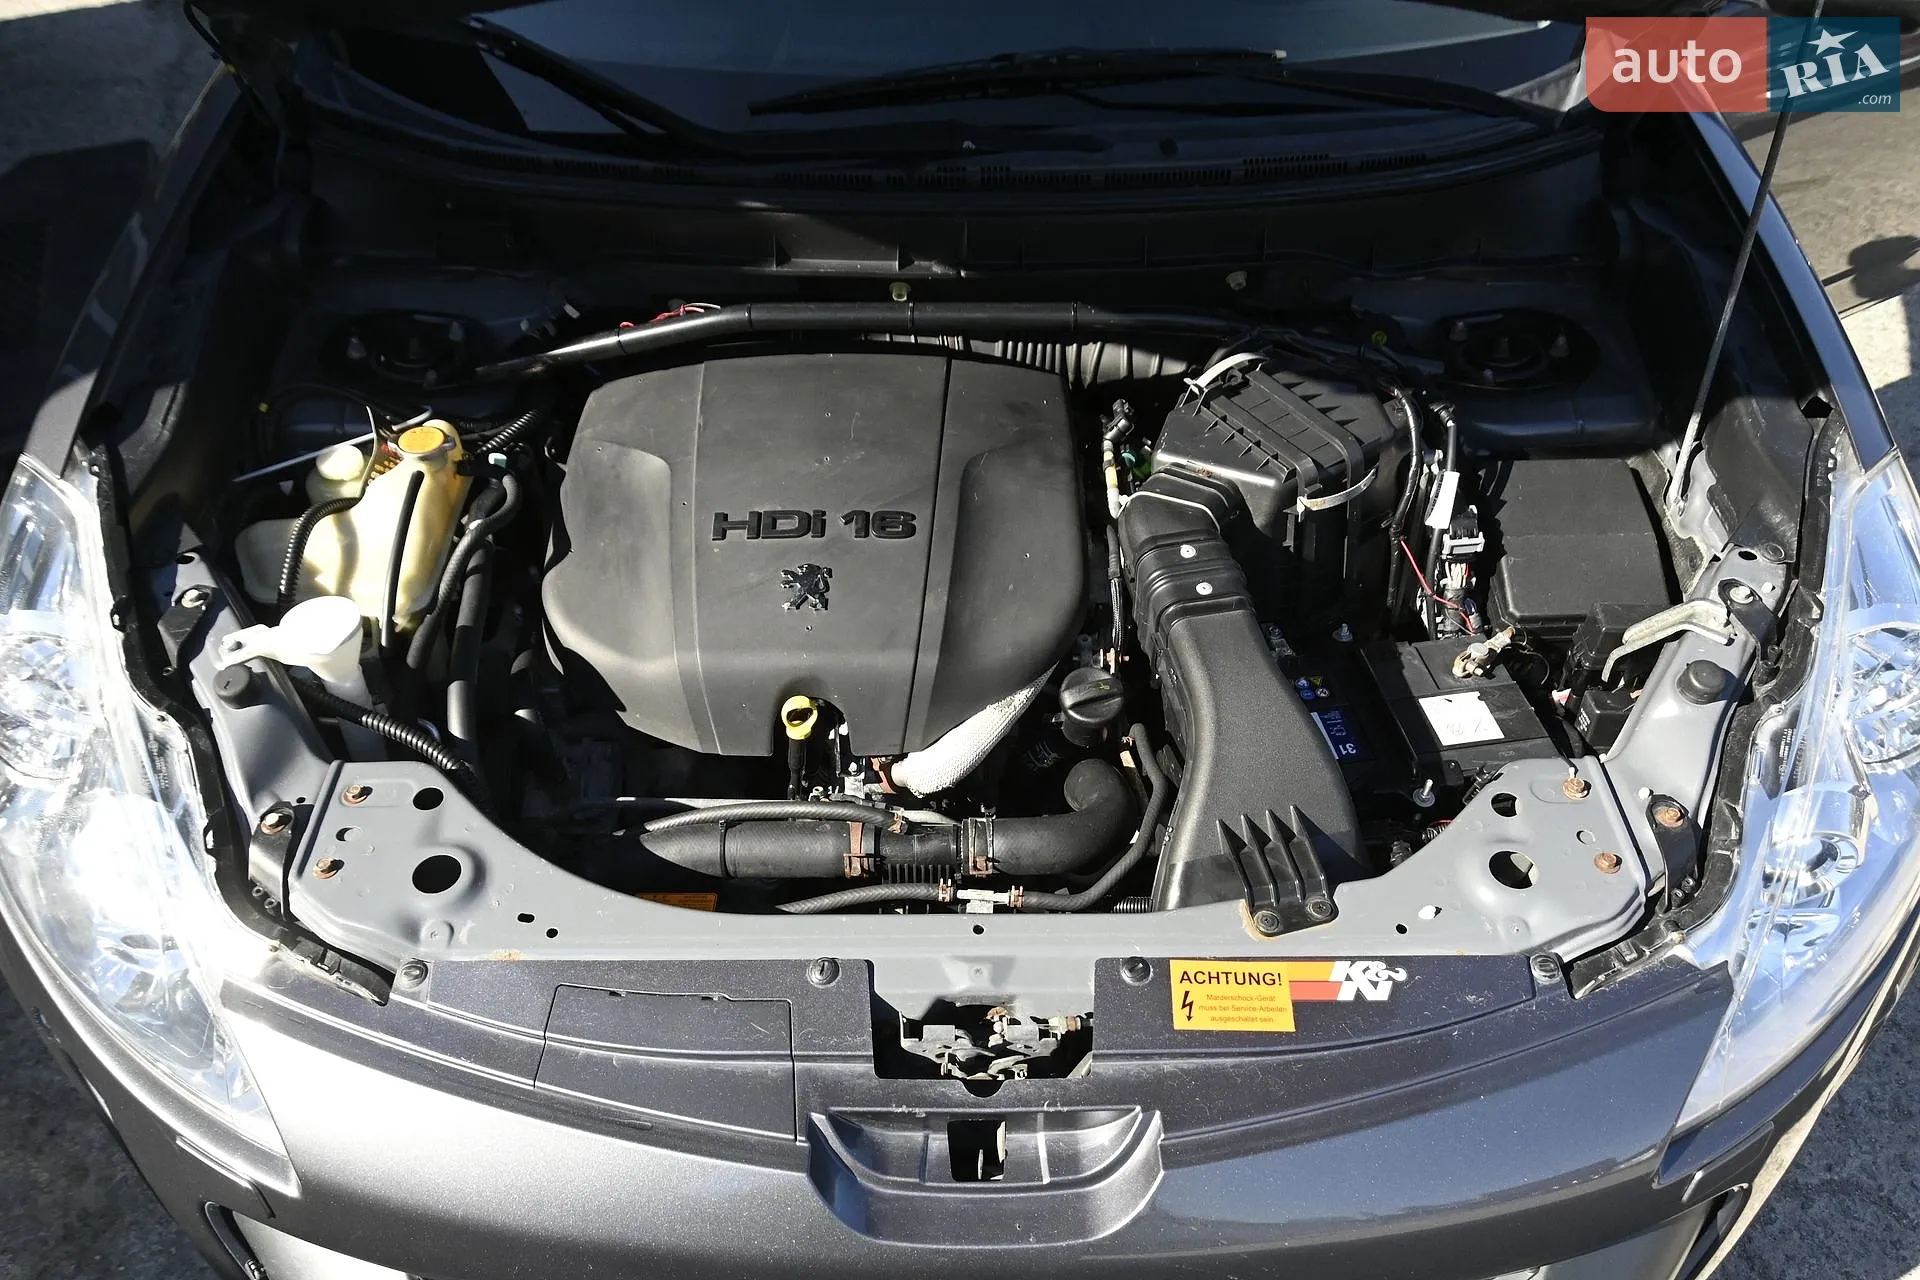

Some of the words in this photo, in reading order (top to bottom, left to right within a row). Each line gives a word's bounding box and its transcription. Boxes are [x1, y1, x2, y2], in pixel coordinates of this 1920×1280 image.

[712, 510, 827, 541] HDi
[840, 510, 917, 539] 16
[1179, 970, 1283, 986] ACHTUNG!
